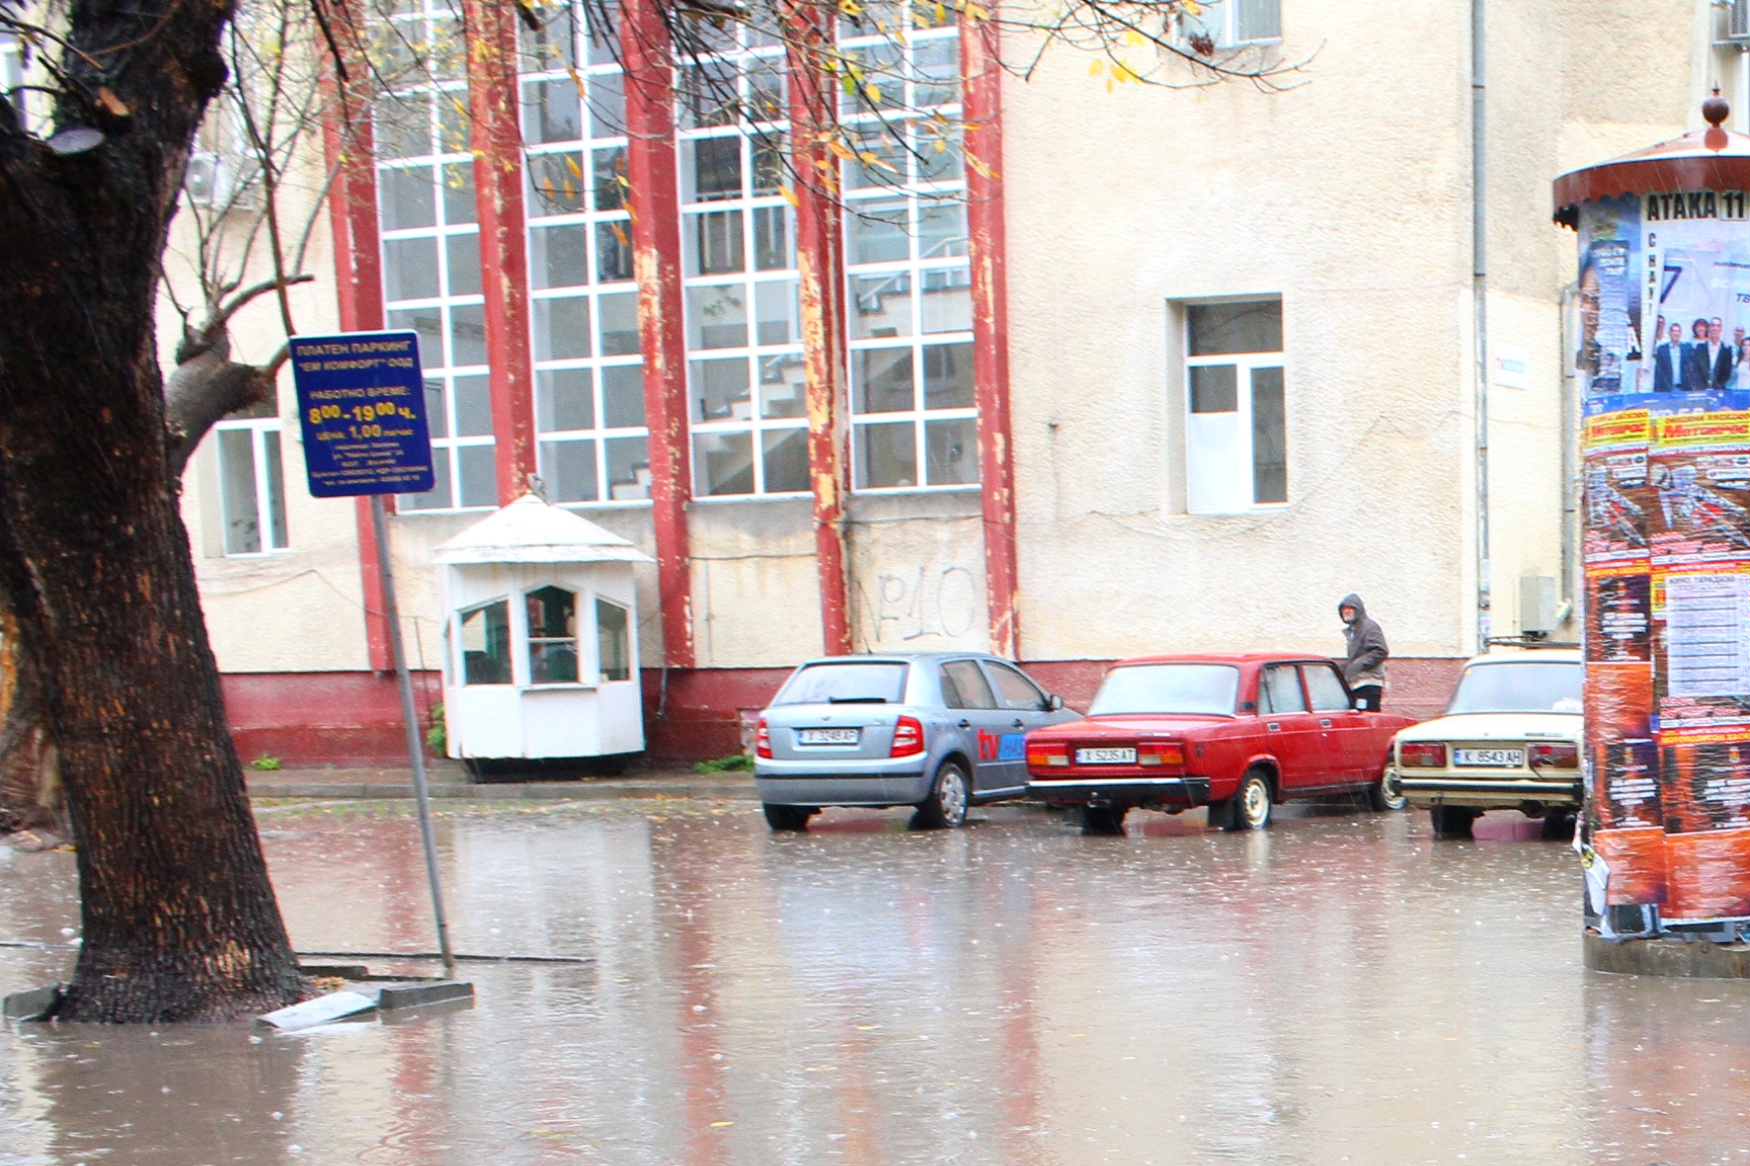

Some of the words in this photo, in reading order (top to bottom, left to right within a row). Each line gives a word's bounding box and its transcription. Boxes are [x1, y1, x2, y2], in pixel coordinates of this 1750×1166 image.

[1648, 192, 1717, 221] АТАКА
[1721, 191, 1745, 219] 11
[1661, 265, 1682, 304] 7
[296, 344, 349, 356] ПЛАТЕН
[351, 340, 411, 353] ПАРКИНГ
[366, 385, 411, 397] ВРЕМЕ:
[348, 424, 381, 440] 1,00
